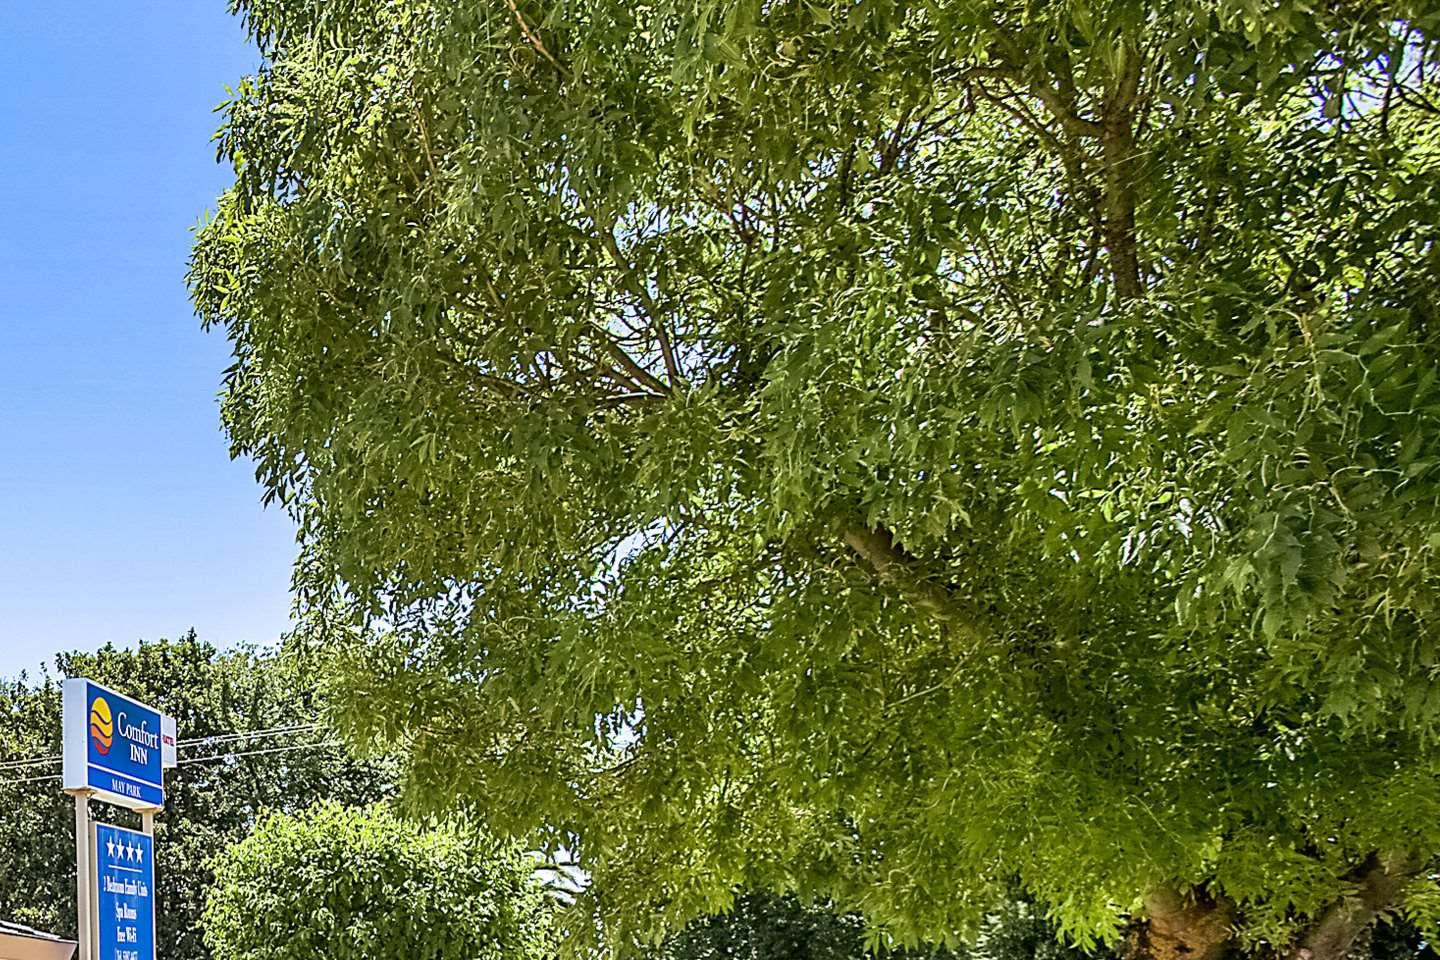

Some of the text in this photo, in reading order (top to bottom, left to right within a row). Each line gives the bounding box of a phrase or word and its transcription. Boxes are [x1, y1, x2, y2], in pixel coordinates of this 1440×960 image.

[117, 711, 159, 749] Comfort
[130, 743, 148, 765] INN
[112, 778, 141, 798] MAY PARK
